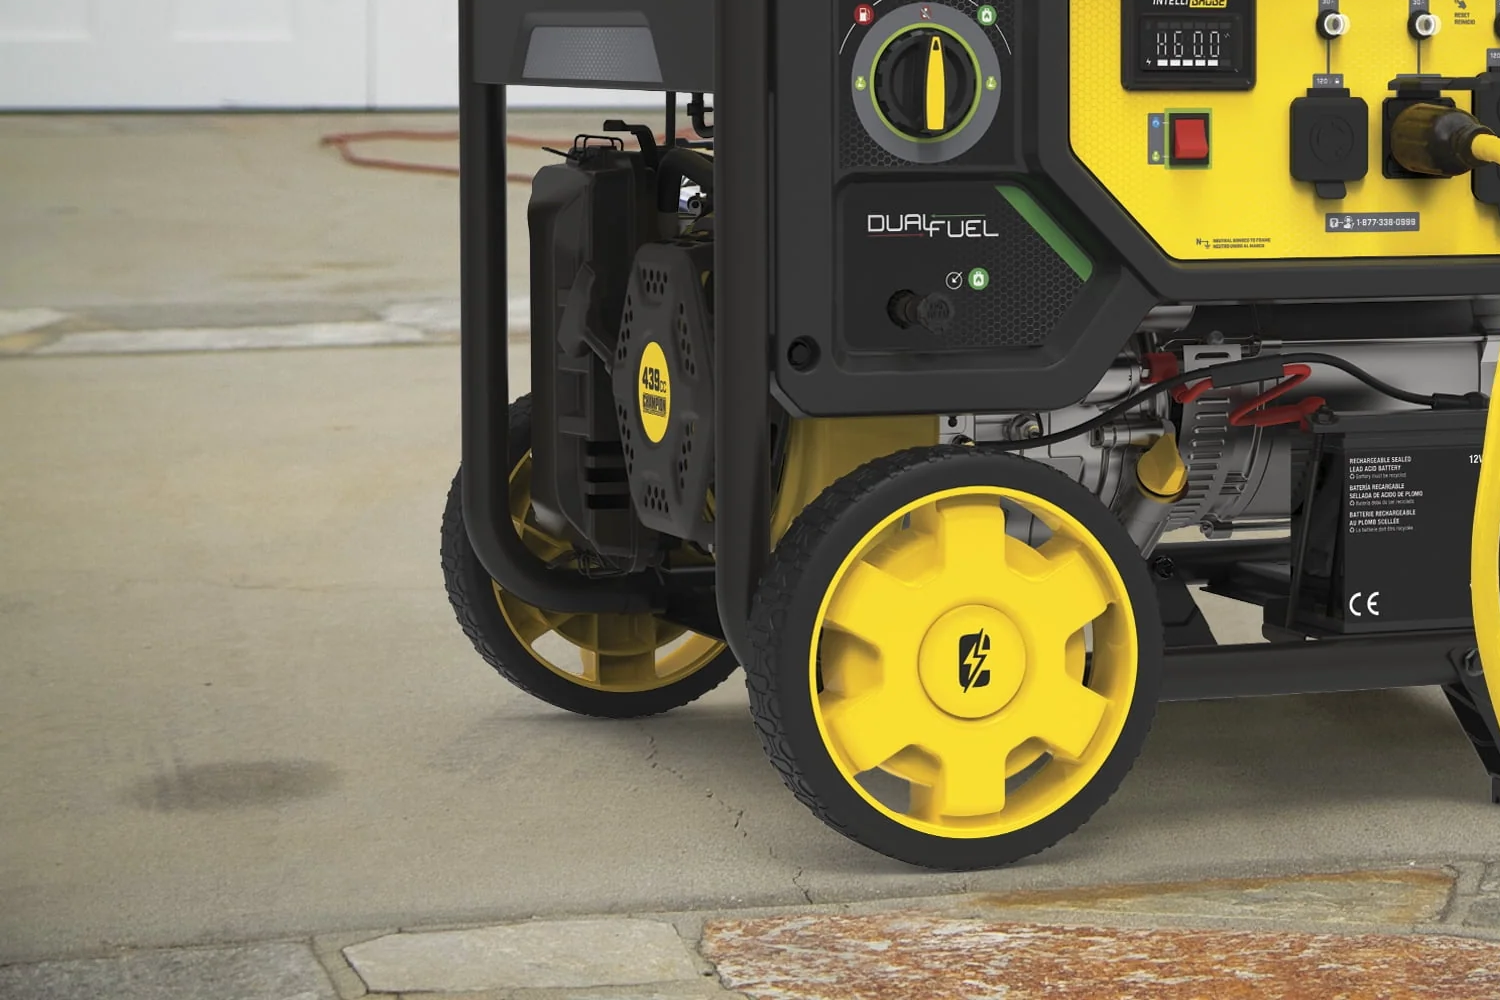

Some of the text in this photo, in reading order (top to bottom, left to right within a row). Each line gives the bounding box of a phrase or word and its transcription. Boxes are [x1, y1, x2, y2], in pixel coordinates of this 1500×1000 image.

[1349, 455, 1412, 464] RECHARGEABLE SEALED
[1349, 465, 1364, 473] LEAD
[1378, 464, 1401, 472] BATTERY
[1405, 490, 1423, 498] PLOMO
[1349, 509, 1416, 518] BATTERIE RECHARGEABLE
[1348, 591, 1380, 617] CE
